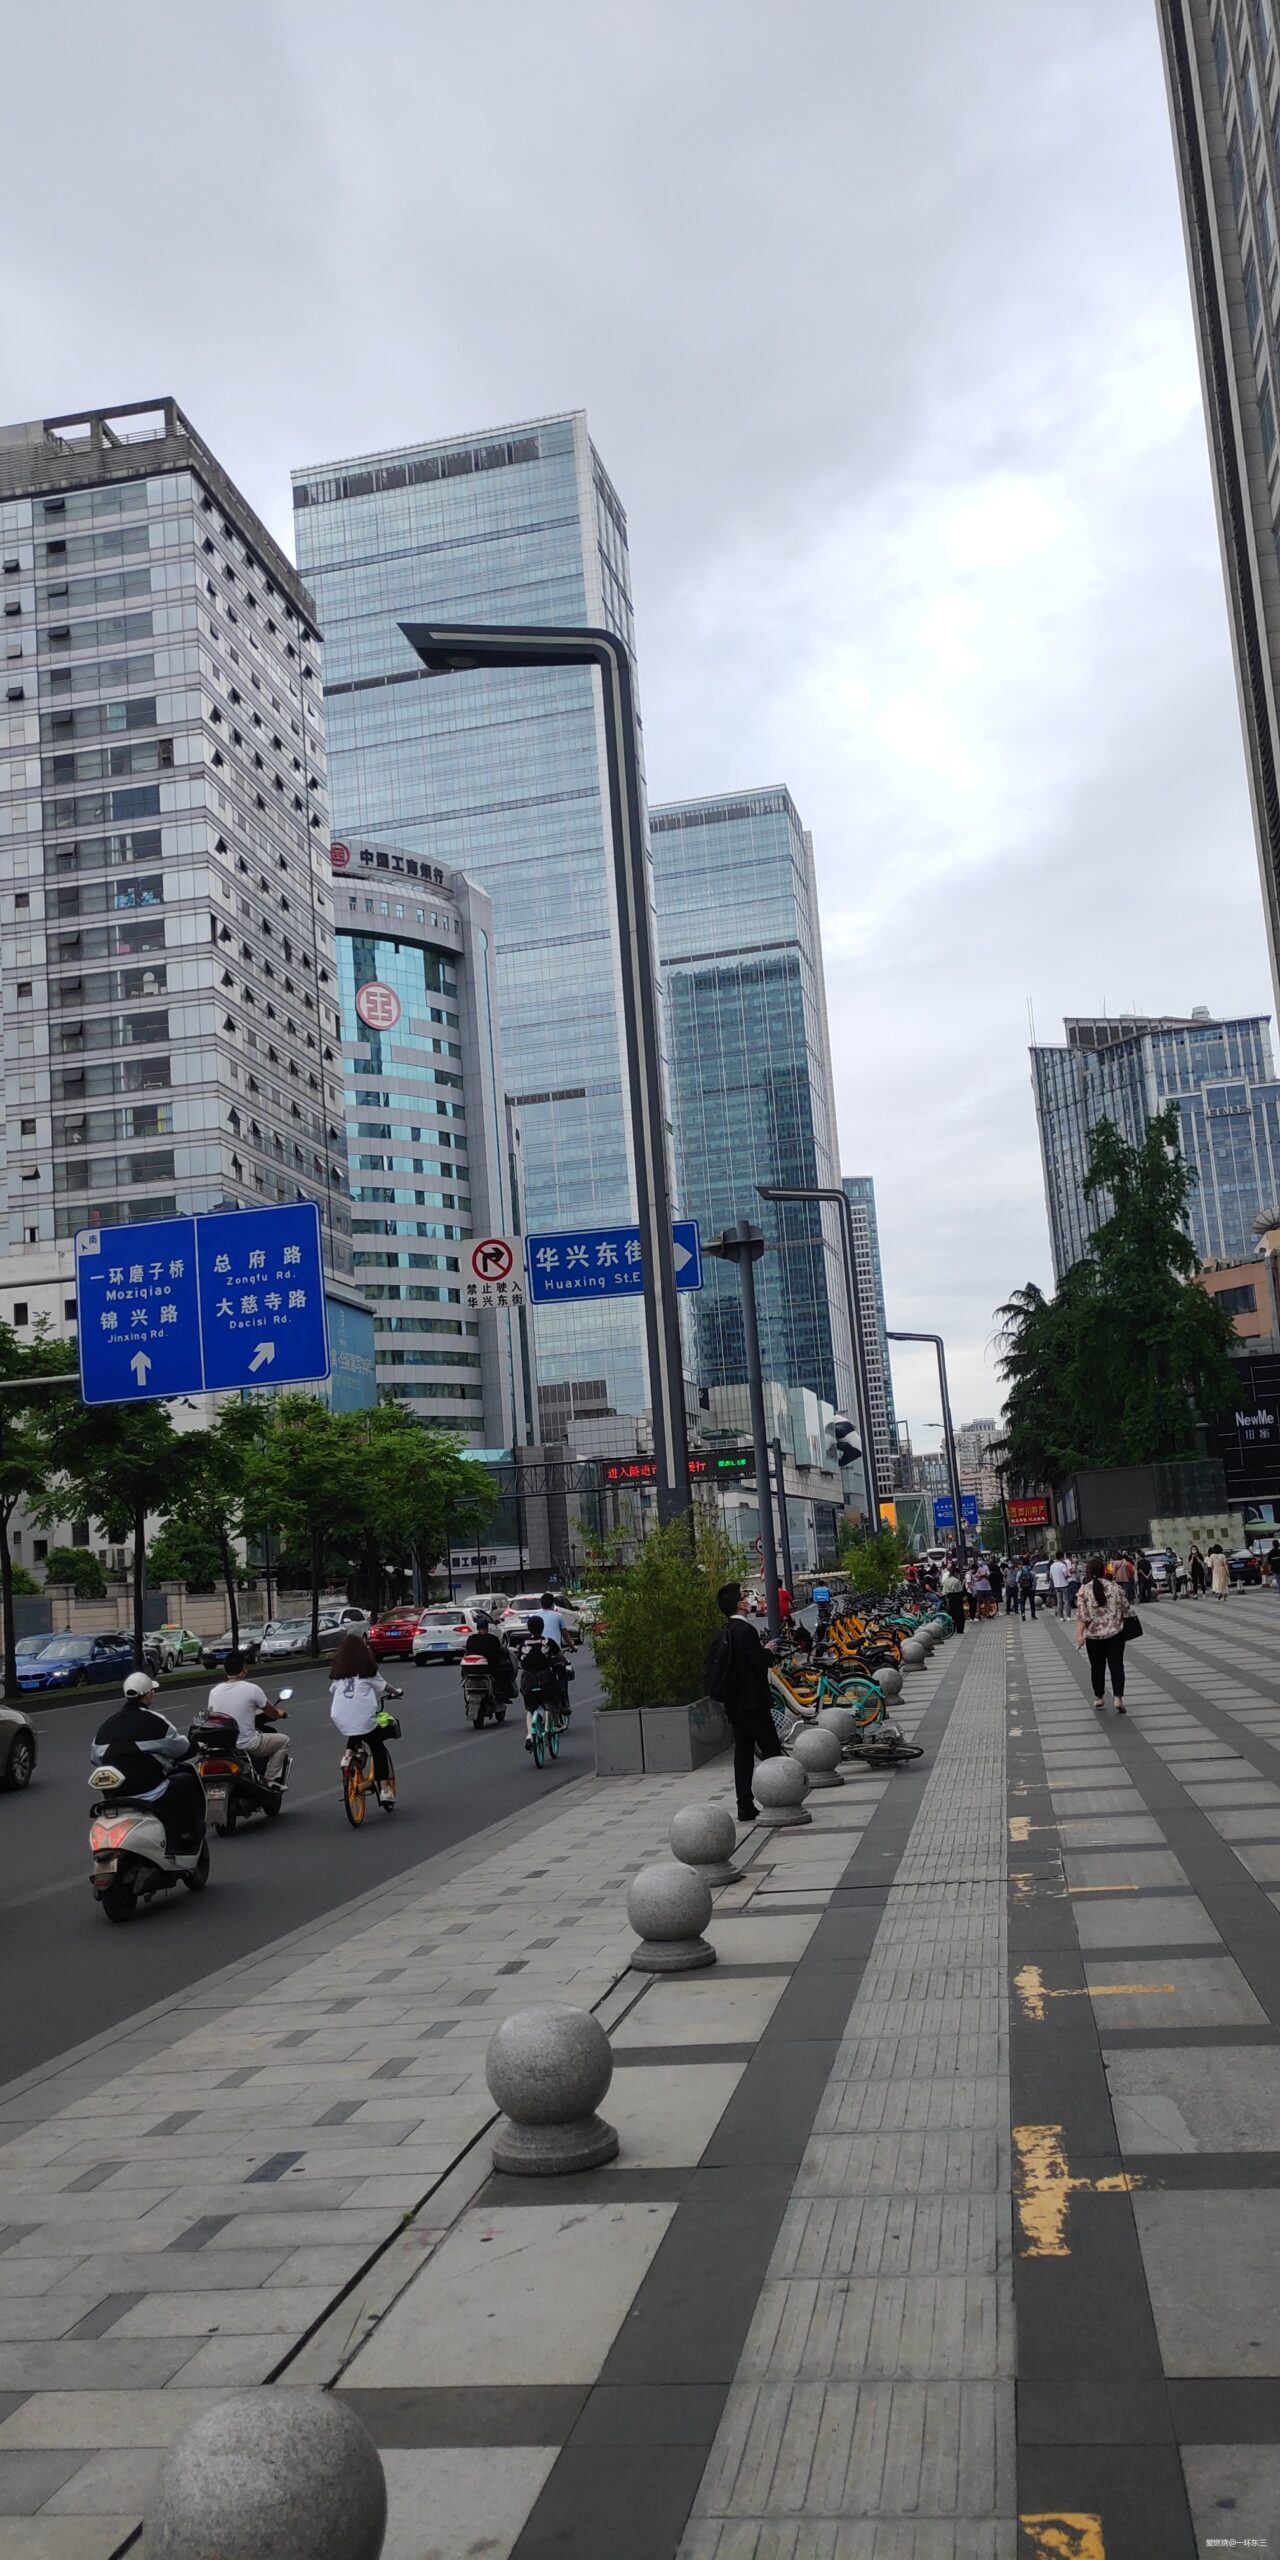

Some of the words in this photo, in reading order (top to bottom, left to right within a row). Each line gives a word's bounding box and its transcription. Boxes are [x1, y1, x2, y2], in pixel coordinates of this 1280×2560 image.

[360, 849, 444, 884] 中国工商银行
[213, 1245, 301, 1273] 总府路
[90, 1259, 185, 1285] 一环磨子桥
[226, 1273, 268, 1285] Zongfu
[276, 1270, 296, 1280] Rd.
[466, 1281, 523, 1296] 禁止驶入
[545, 1276, 606, 1291] Huaxing
[106, 1285, 172, 1301] Moziqiao
[467, 1293, 524, 1309] 华兴东街
[216, 1289, 307, 1317] 大慈寺路
[100, 1303, 179, 1330] 锦兴路
[229, 1316, 267, 1329] Dacisi
[273, 1314, 292, 1324] Rd.
[107, 1331, 147, 1343] Jinxing
[150, 1329, 168, 1338] Rd.
[1235, 1408, 1274, 1427] NewMe
